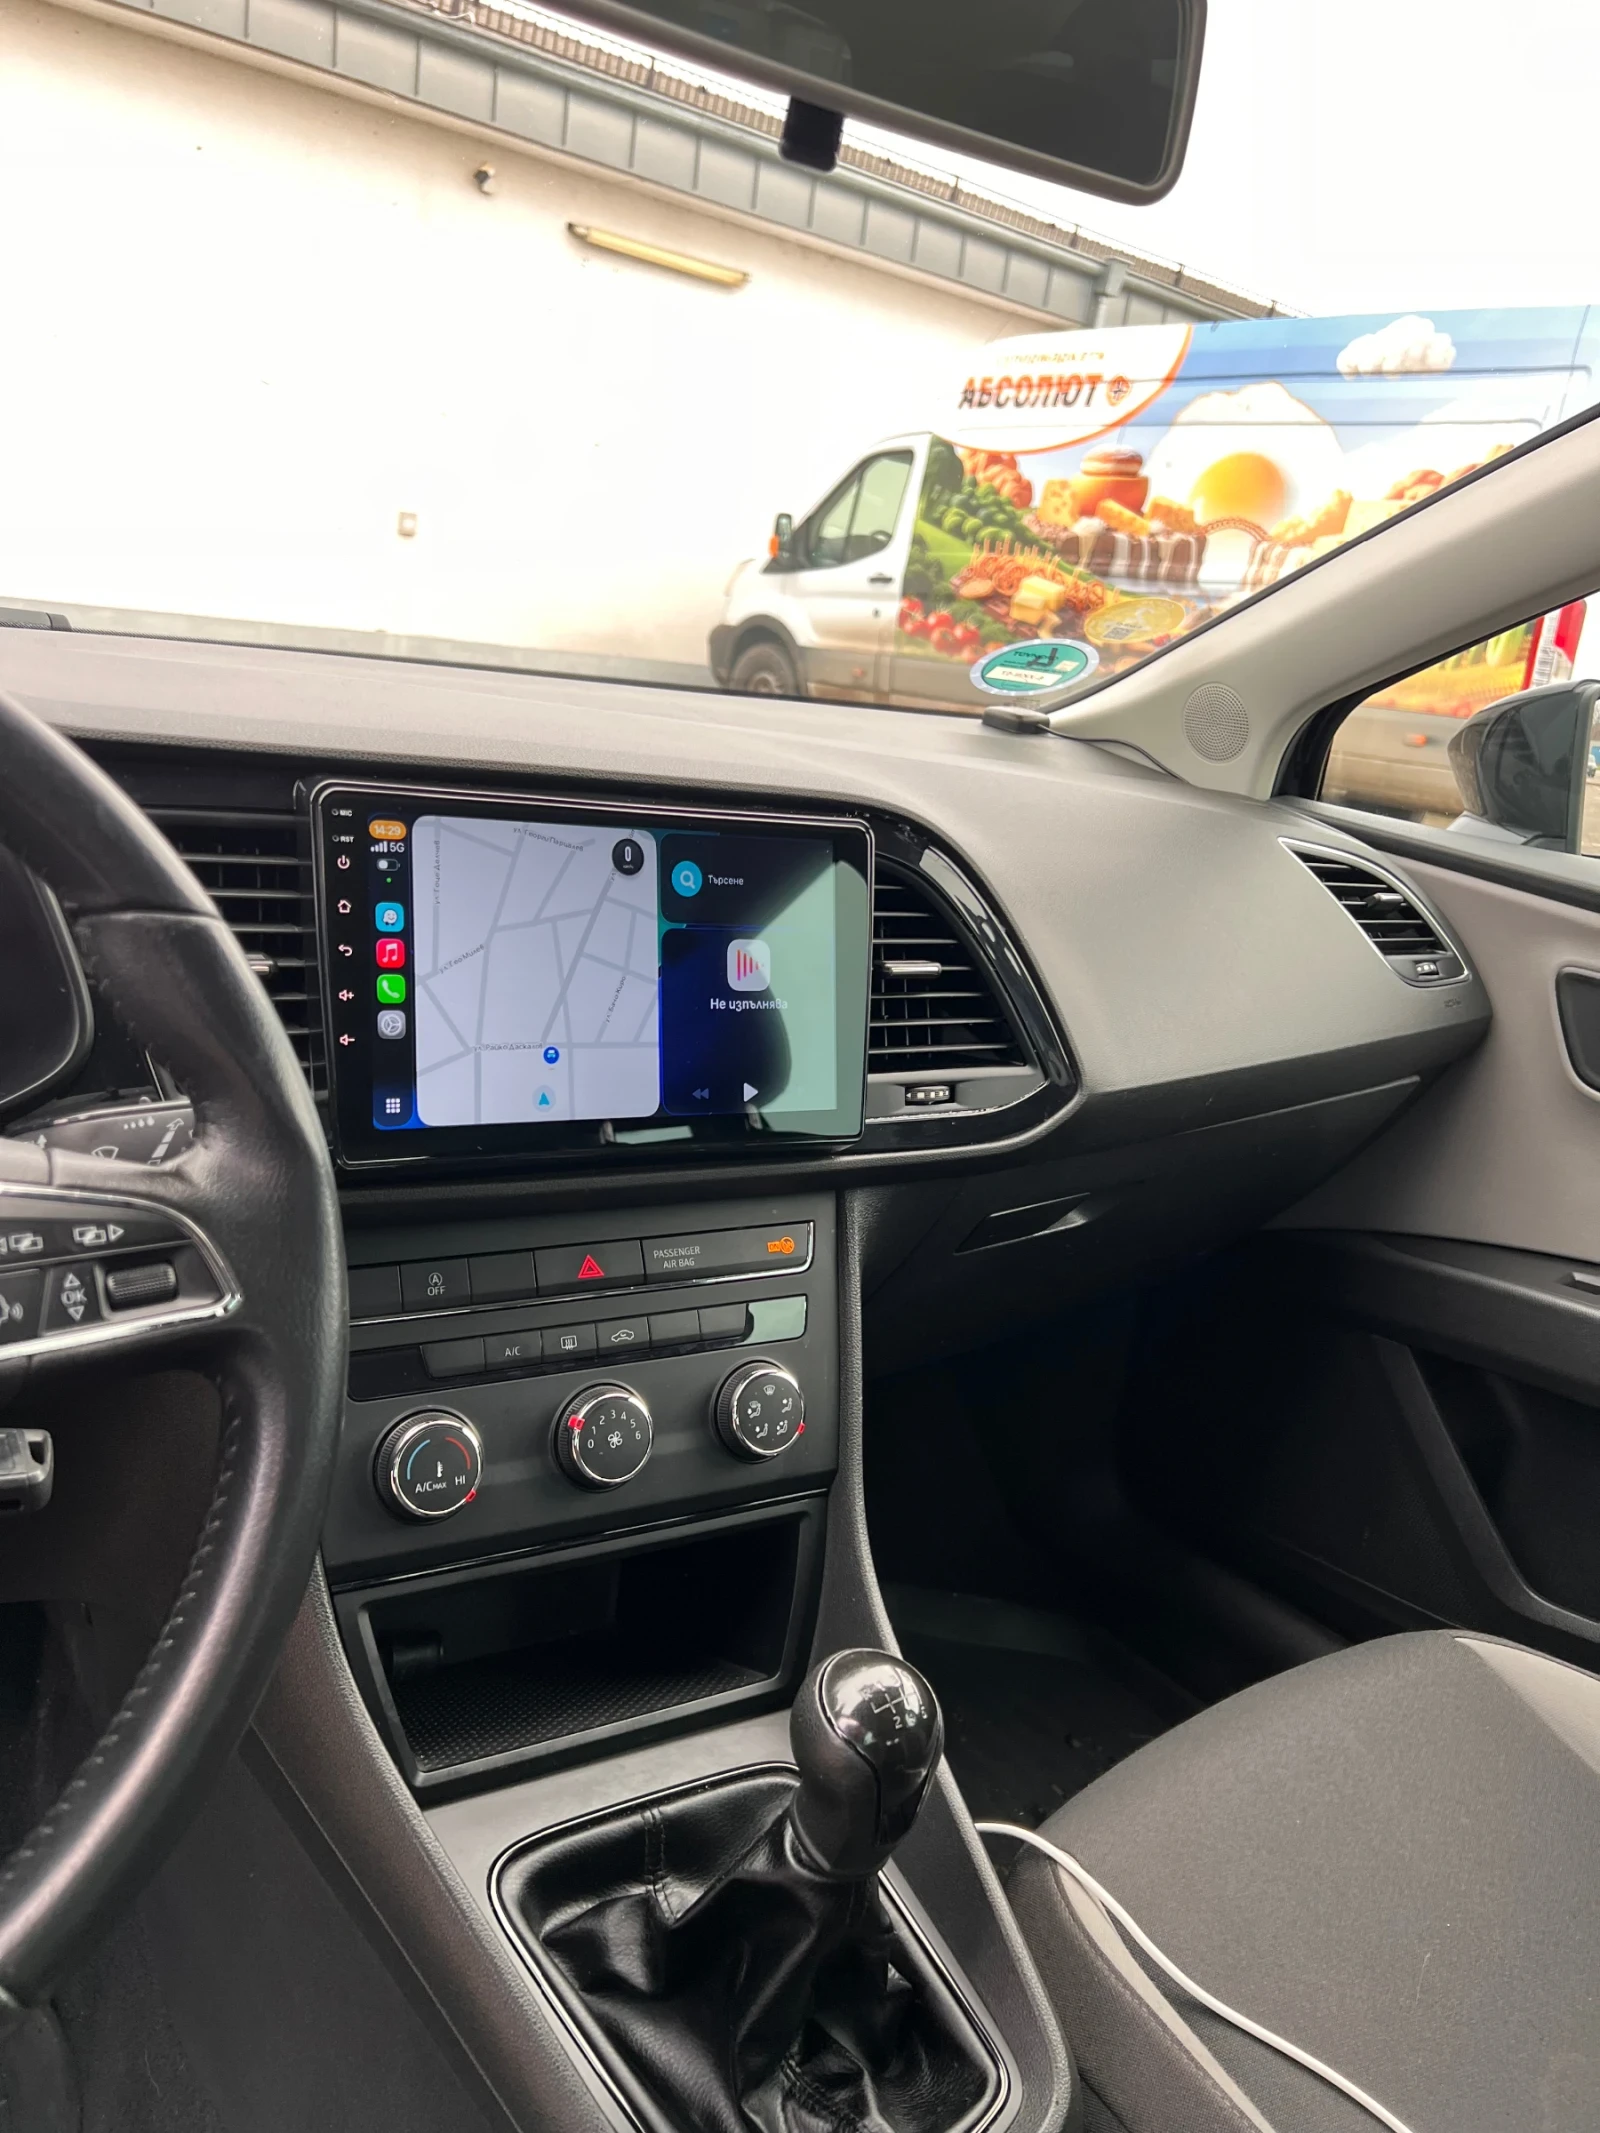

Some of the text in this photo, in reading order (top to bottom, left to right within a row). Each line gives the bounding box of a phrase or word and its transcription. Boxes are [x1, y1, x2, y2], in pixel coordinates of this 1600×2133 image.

[958, 374, 1103, 409] АБСОЛЮТ
[390, 843, 405, 853] 5G
[625, 846, 631, 862] 0
[708, 875, 744, 885] Търсене
[710, 998, 788, 1012] Не изпълнява
[653, 1246, 701, 1259] PASSENGER
[663, 1257, 695, 1269] AIR BAG
[427, 1286, 446, 1296] OFF
[61, 1288, 88, 1305] OK
[505, 1346, 520, 1357] A/C
[610, 1409, 616, 1419] 3
[621, 1411, 627, 1420] 4
[600, 1415, 605, 1425] 2
[630, 1418, 636, 1428] 5
[592, 1426, 596, 1435] 1
[636, 1430, 641, 1440] 6
[587, 1439, 594, 1449] 0
[455, 1474, 466, 1486] HI
[893, 1716, 903, 1730] 2
